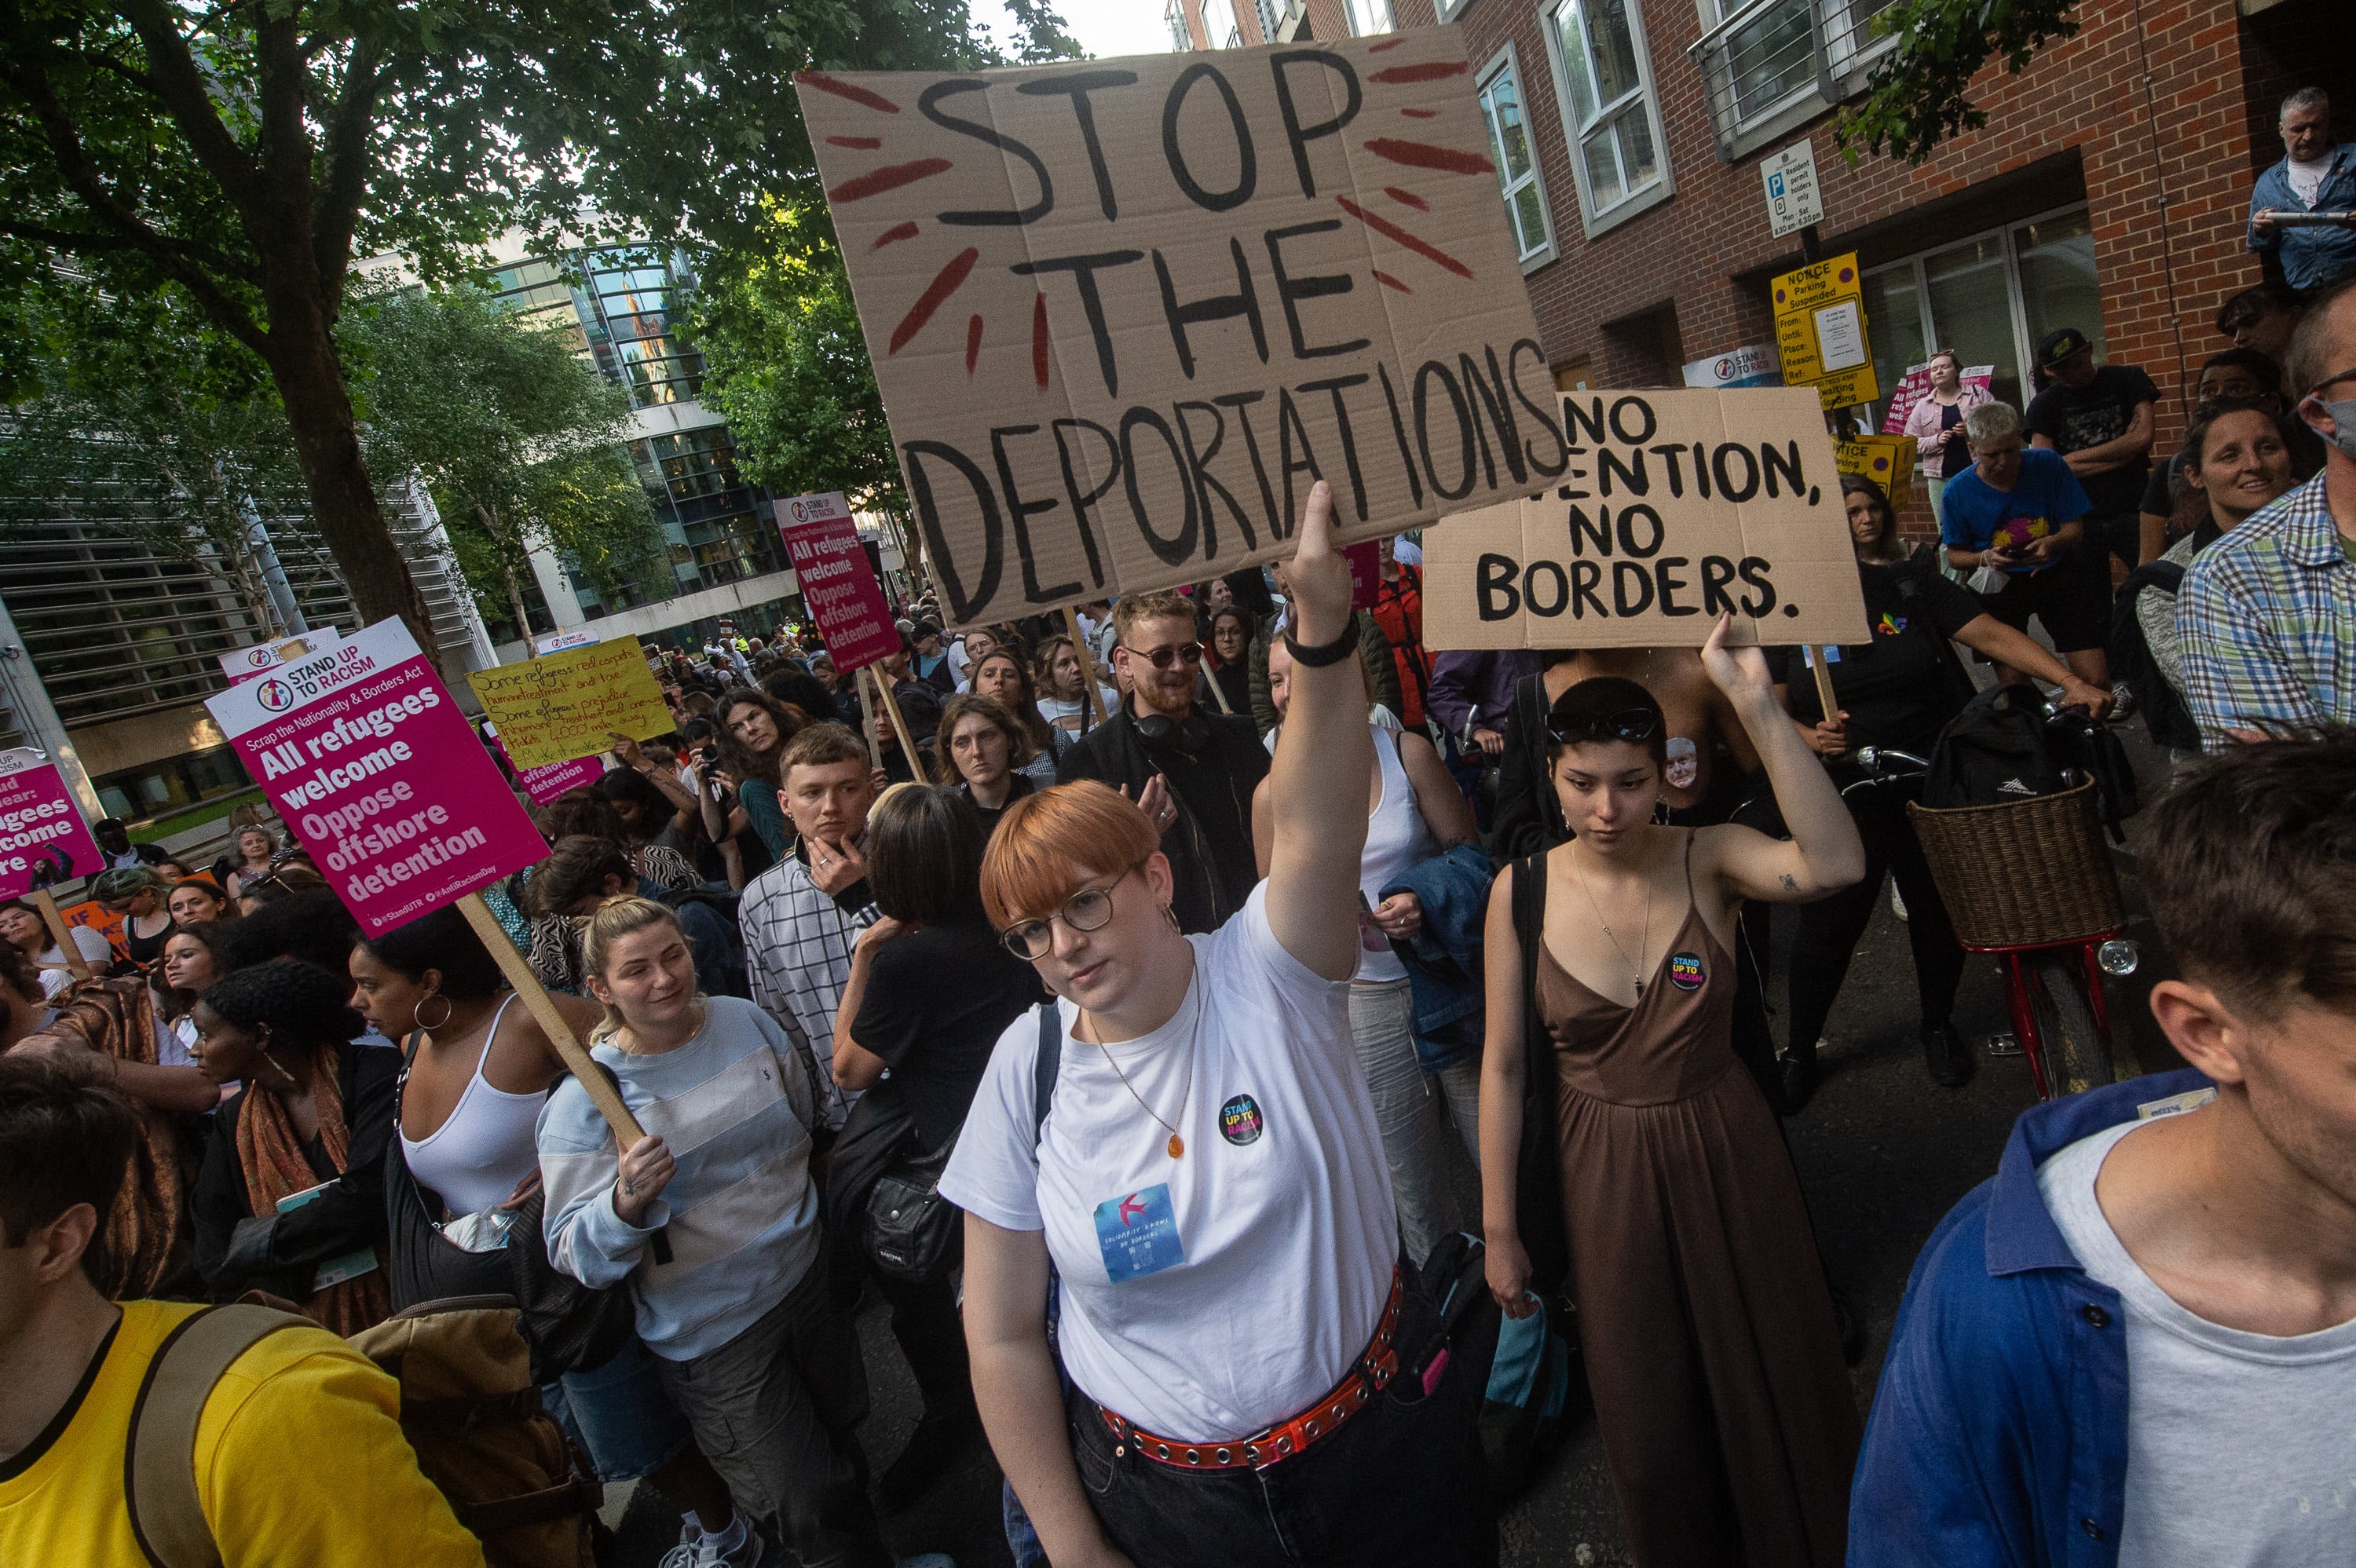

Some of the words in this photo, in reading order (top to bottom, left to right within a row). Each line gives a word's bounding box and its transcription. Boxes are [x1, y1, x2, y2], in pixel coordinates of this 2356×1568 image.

[917, 49, 1363, 225] STOP
[1786, 159, 1809, 176] Resident
[1791, 171, 1809, 185] permit
[1772, 175, 1781, 196] P
[1791, 181, 1811, 194] holders
[1797, 192, 1809, 203] only
[1775, 225, 1787, 236] 8.30
[1813, 212, 1821, 221] pm
[1783, 214, 1794, 222] Mon
[1798, 207, 1809, 216] Sat
[1794, 280, 1826, 295] Parking
[1009, 221, 1372, 397] THE
[1790, 288, 1836, 309] Suspended
[1780, 317, 1801, 328] From:
[1782, 331, 1802, 341] Until:
[1784, 343, 1807, 353] Place:
[1738, 364, 1749, 374] TO
[1786, 355, 1817, 367] Reason:
[1789, 370, 1805, 380] Ref:
[1821, 382, 1854, 396] waiting
[1894, 393, 1904, 402] All
[1563, 396, 1657, 446] NO
[901, 338, 1569, 624] DEPORTATIONS
[1563, 440, 1821, 506] ENTION,
[1571, 503, 1664, 557] NO
[792, 539, 813, 561] All
[812, 534, 858, 554] refugees
[800, 558, 853, 583] welcome
[809, 582, 856, 606] Oppose
[1476, 553, 1799, 620] BORDERS.
[820, 601, 868, 627] offshore
[829, 620, 881, 649] detention
[288, 656, 336, 685] STAND
[340, 645, 359, 663] UP
[473, 671, 524, 691] Some
[576, 656, 595, 671] red
[296, 682, 318, 698] TO
[318, 656, 376, 689] RACISM
[576, 677, 595, 689] and
[600, 671, 620, 683] love
[246, 733, 277, 751] Scrap
[276, 723, 295, 739] the
[294, 699, 350, 730] Nationality
[350, 693, 362, 704] &
[360, 675, 404, 700] Borders
[404, 665, 424, 682] Act
[489, 705, 533, 724] Some
[499, 722, 552, 736] inhumane
[561, 711, 604, 724] treatment
[606, 702, 624, 717] and
[259, 740, 304, 781] All
[306, 686, 440, 759] refugees
[507, 735, 542, 750] tickets
[591, 720, 614, 732] miles
[619, 713, 646, 728] away
[558, 743, 566, 757] it
[571, 741, 597, 755] make
[599, 740, 616, 749] sen
[0, 762, 24, 774] CISM
[280, 740, 412, 810] welcome
[530, 765, 584, 795] detention
[302, 780, 415, 841] Oppose
[327, 805, 449, 872] offshore
[347, 825, 487, 902] detention
[381, 899, 424, 923] @StandUTR
[434, 865, 496, 897] @AntiRacismDay
[1673, 956, 1699, 967] STAND
[1672, 972, 1703, 982] RACISM
[1225, 1101, 1251, 1116] STAND
[1226, 1115, 1240, 1125] UP
[1242, 1110, 1253, 1121] TO
[1227, 1117, 1260, 1135] RACISM
[1105, 1226, 1140, 1244] SOLIDARITY
[1132, 1231, 1158, 1244] BORDERS
